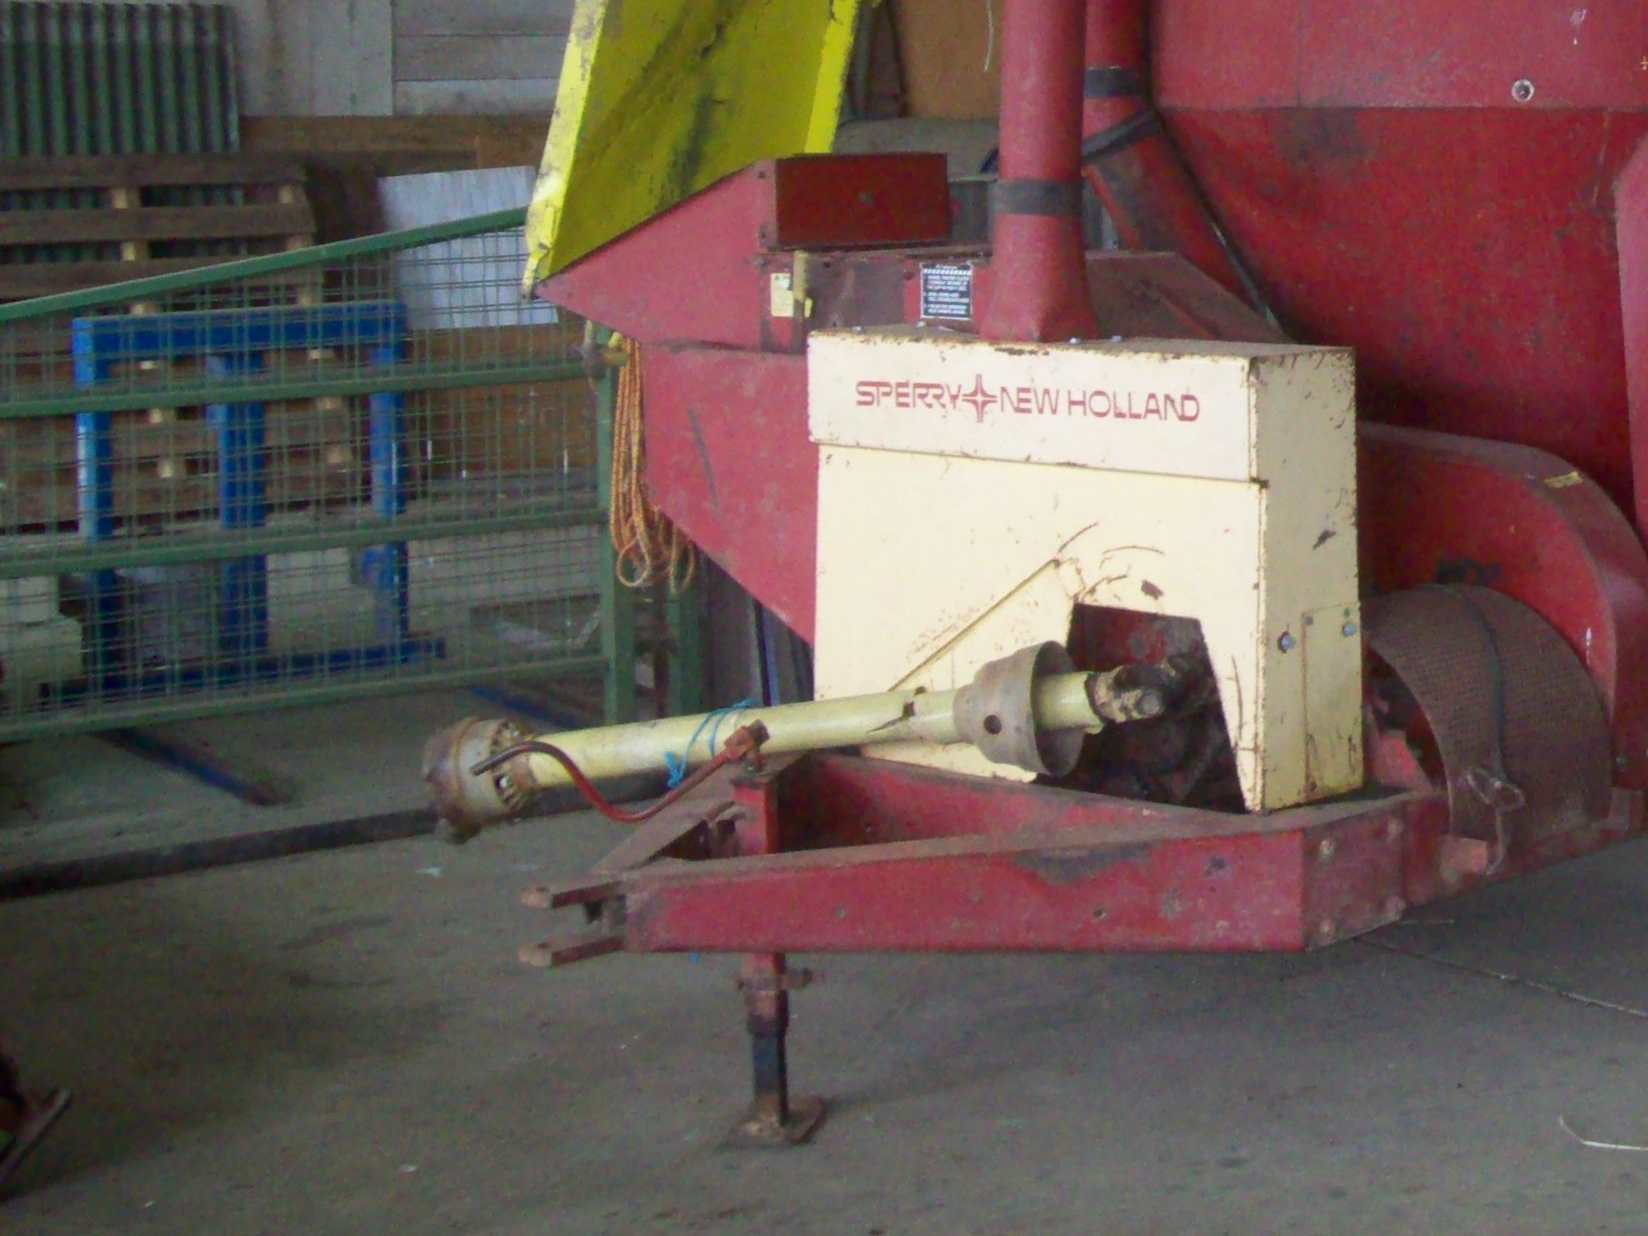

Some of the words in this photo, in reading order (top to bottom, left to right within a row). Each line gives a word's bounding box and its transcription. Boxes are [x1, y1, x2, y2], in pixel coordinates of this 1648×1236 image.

[855, 380, 963, 410] SPERRY
[1000, 385, 1060, 415] NEW
[1067, 389, 1201, 423] HOLLAND
